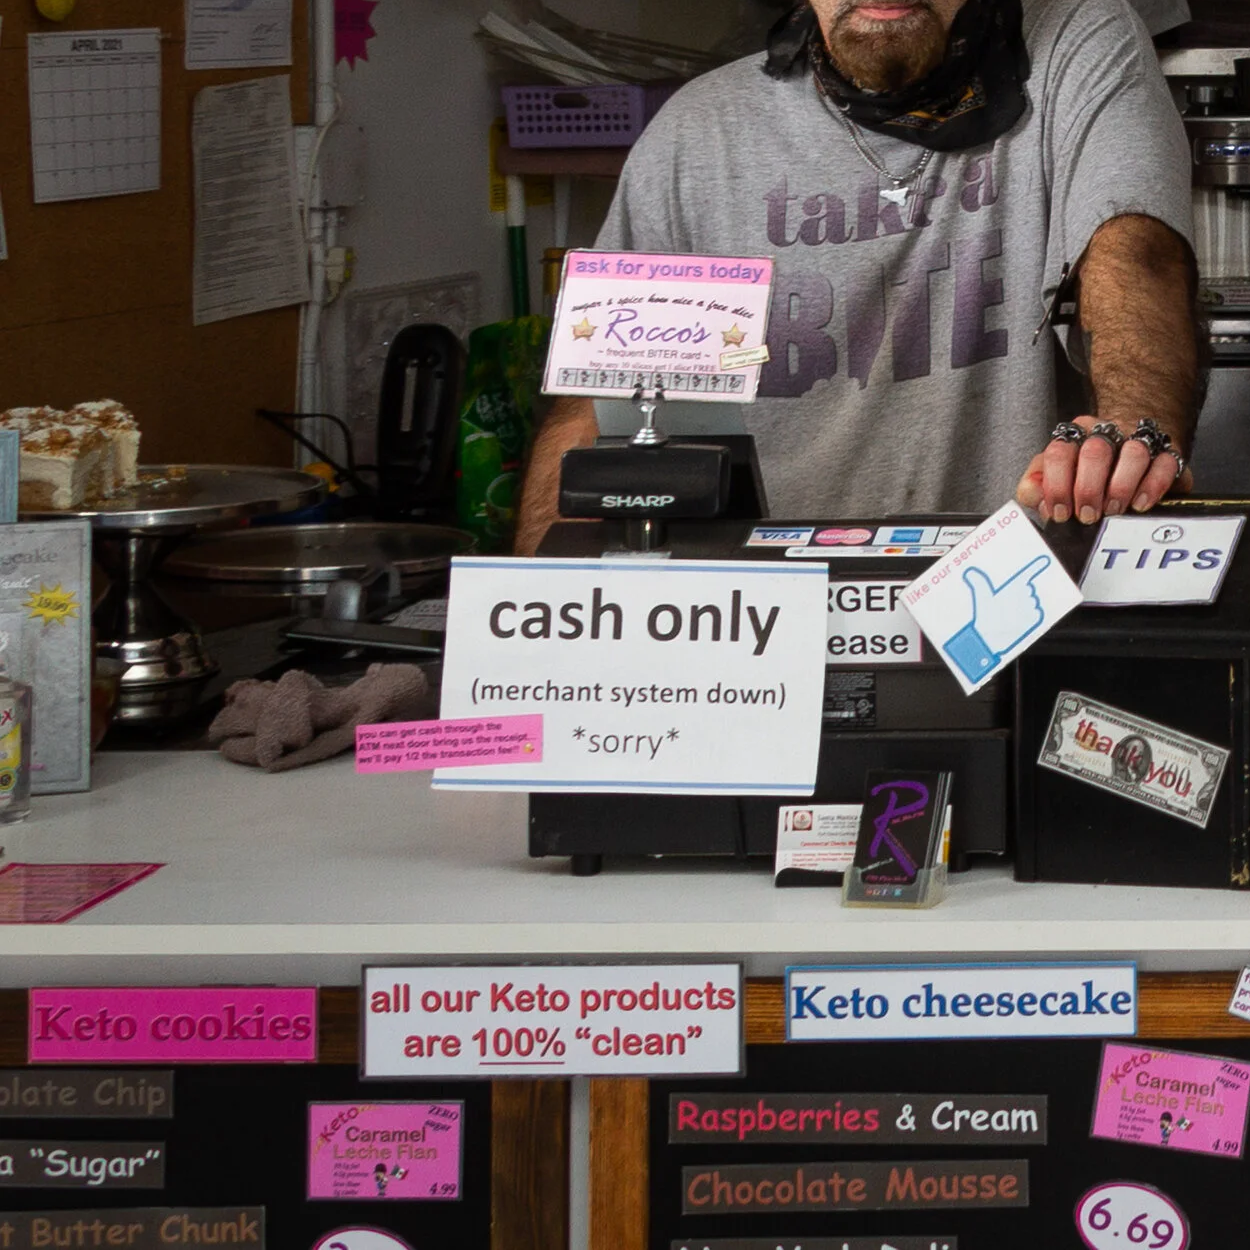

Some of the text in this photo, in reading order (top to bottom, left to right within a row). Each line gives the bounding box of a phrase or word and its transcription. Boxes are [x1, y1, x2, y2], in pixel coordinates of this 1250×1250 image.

[575, 259, 764, 283] ask for yours today
[602, 496, 674, 507] SHARP
[906, 510, 1019, 605] like our service too
[1101, 548, 1222, 571] TIPS
[489, 587, 780, 655] cash only
[471, 678, 603, 704] (merchant
[610, 682, 698, 707] system
[707, 681, 786, 709] down)
[1074, 718, 1193, 798] thank you
[370, 980, 737, 1021] all our Keto products
[791, 982, 1132, 1020] Keto cheesecake
[36, 1004, 312, 1043] Keto cookies
[404, 1032, 461, 1058] are
[473, 1027, 566, 1059] 100%
[1135, 1071, 1216, 1097] Caramel
[676, 1101, 1039, 1140] Raspberries & Cream
[688, 1171, 1018, 1207] Chocolate Mousse
[1088, 1201, 1174, 1248] 6.69
